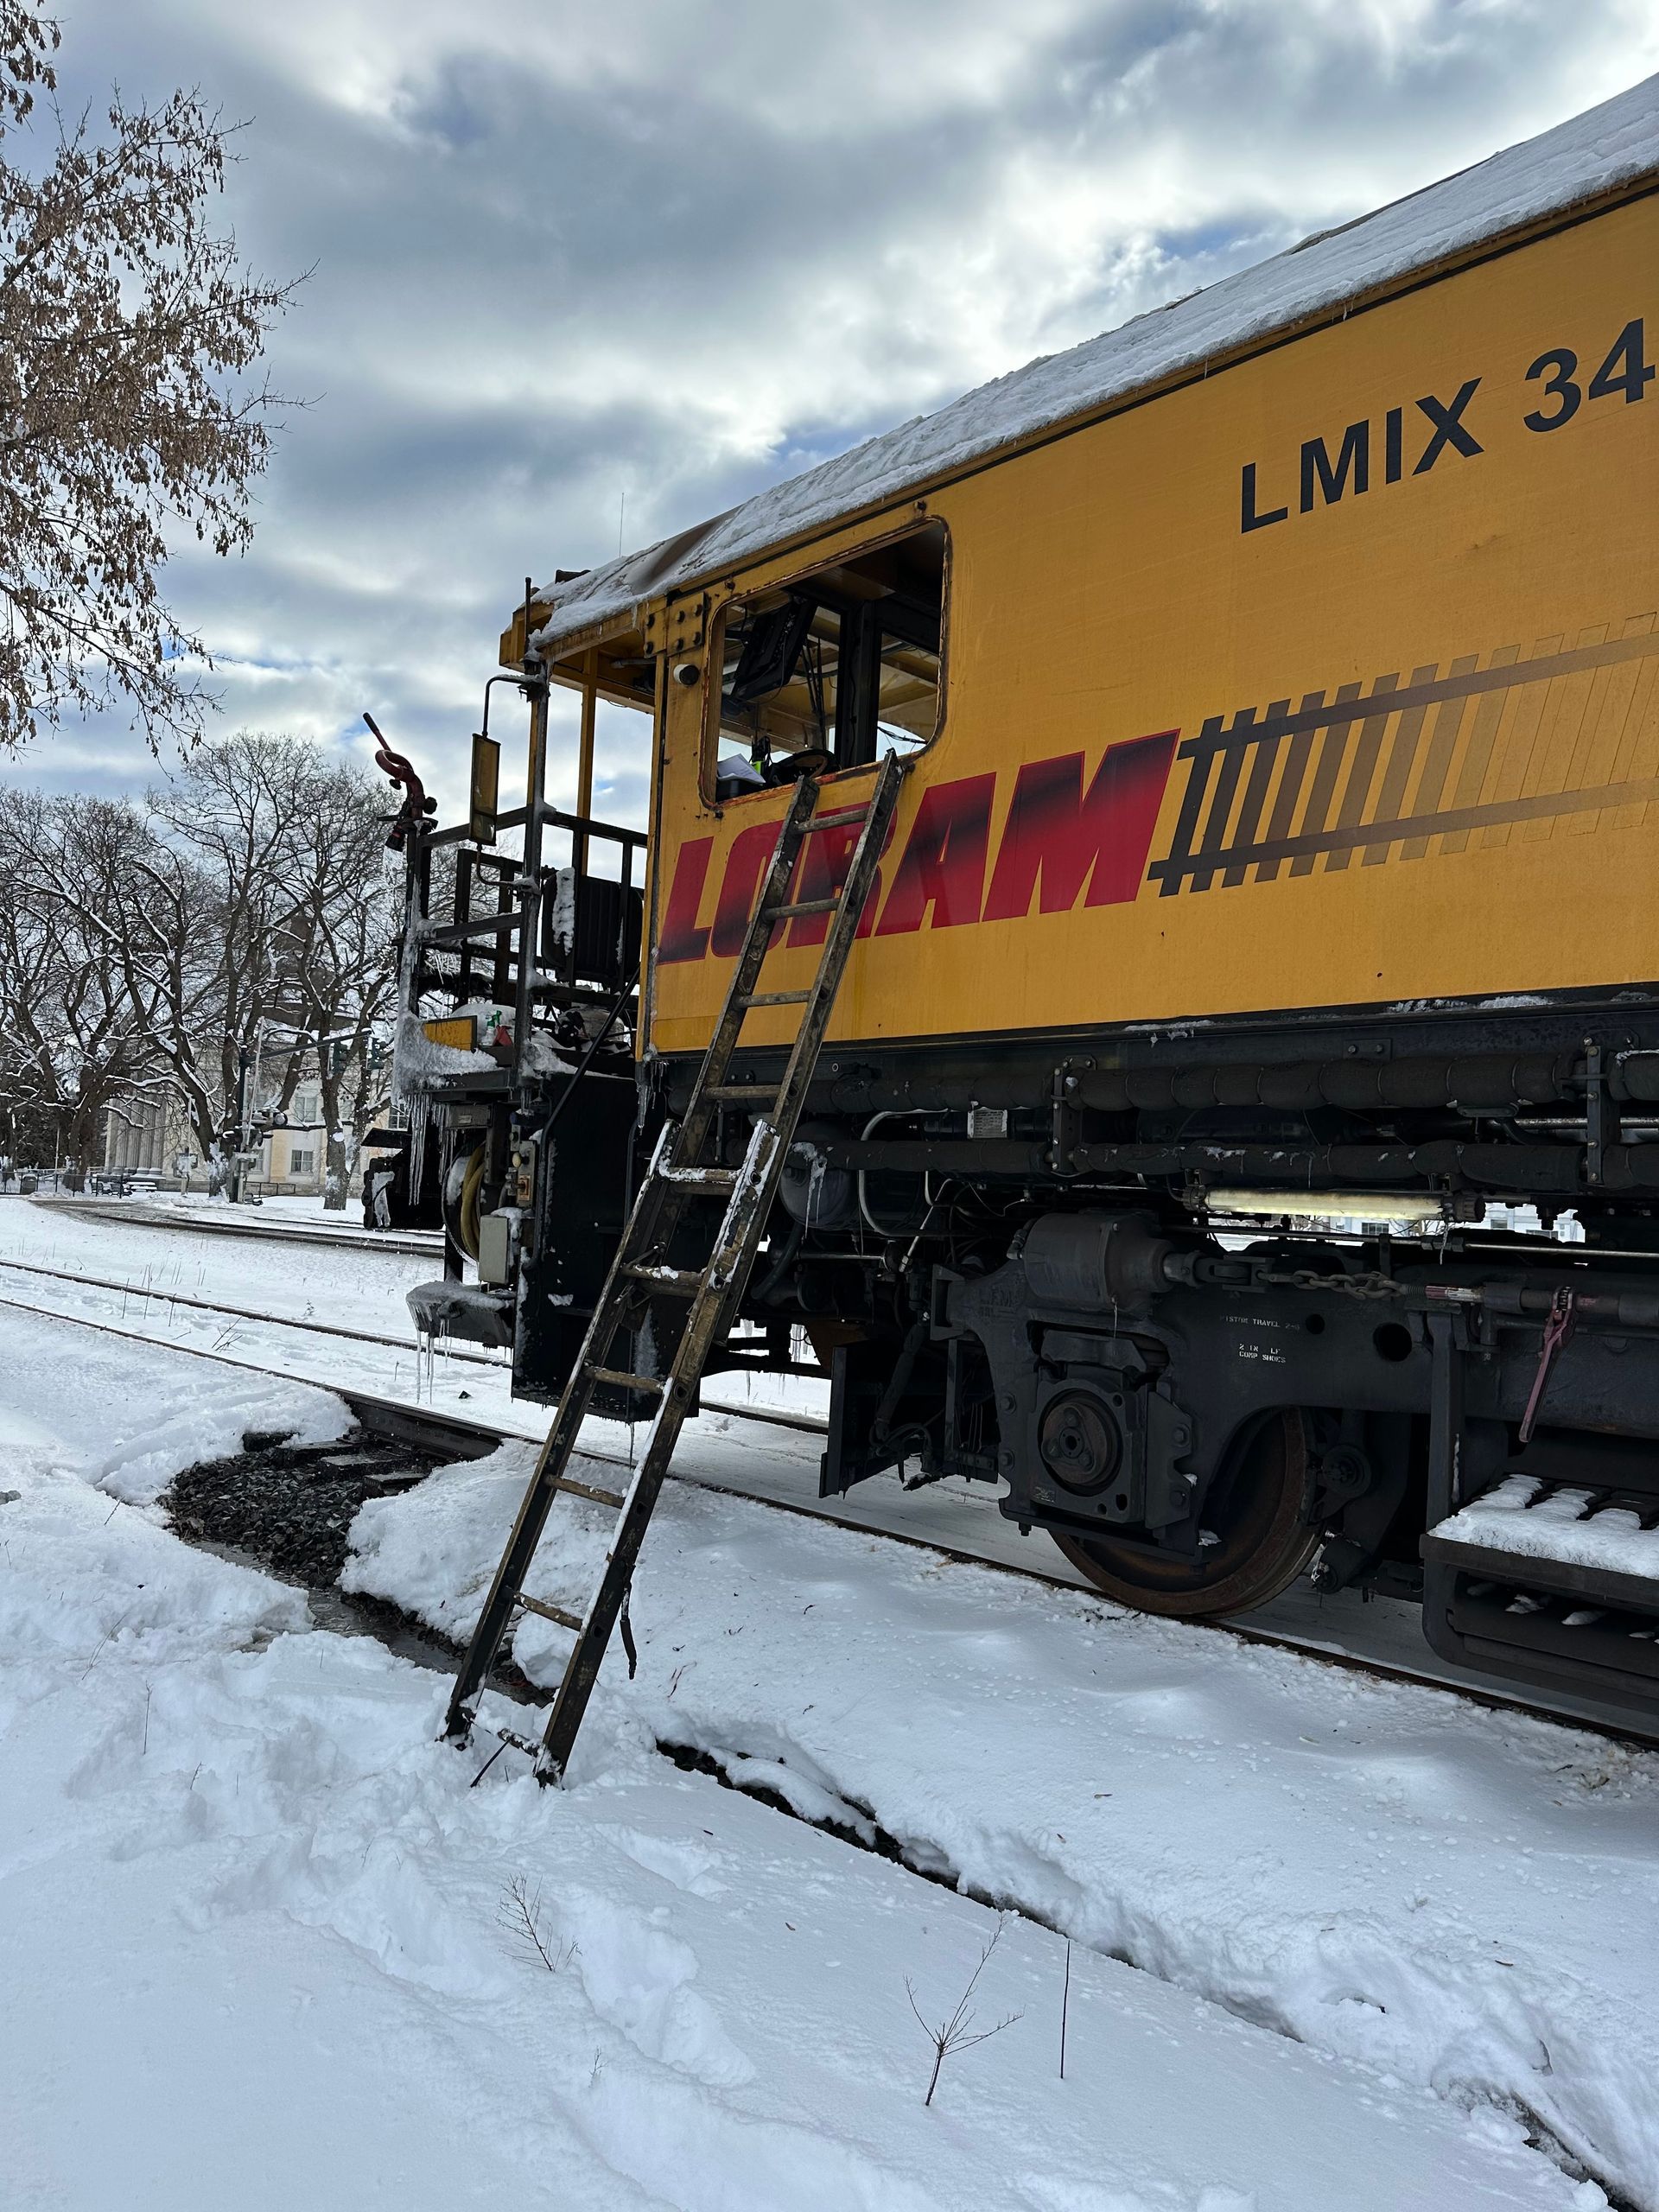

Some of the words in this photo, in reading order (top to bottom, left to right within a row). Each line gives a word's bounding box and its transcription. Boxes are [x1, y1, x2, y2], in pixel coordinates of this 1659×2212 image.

[1241, 376, 1484, 534] LMIX
[1522, 317, 1656, 433] 34
[657, 728, 1182, 965] LORAM
[1252, 1318, 1281, 1328] TRAVEL
[1262, 1354, 1286, 1363] SHOES
